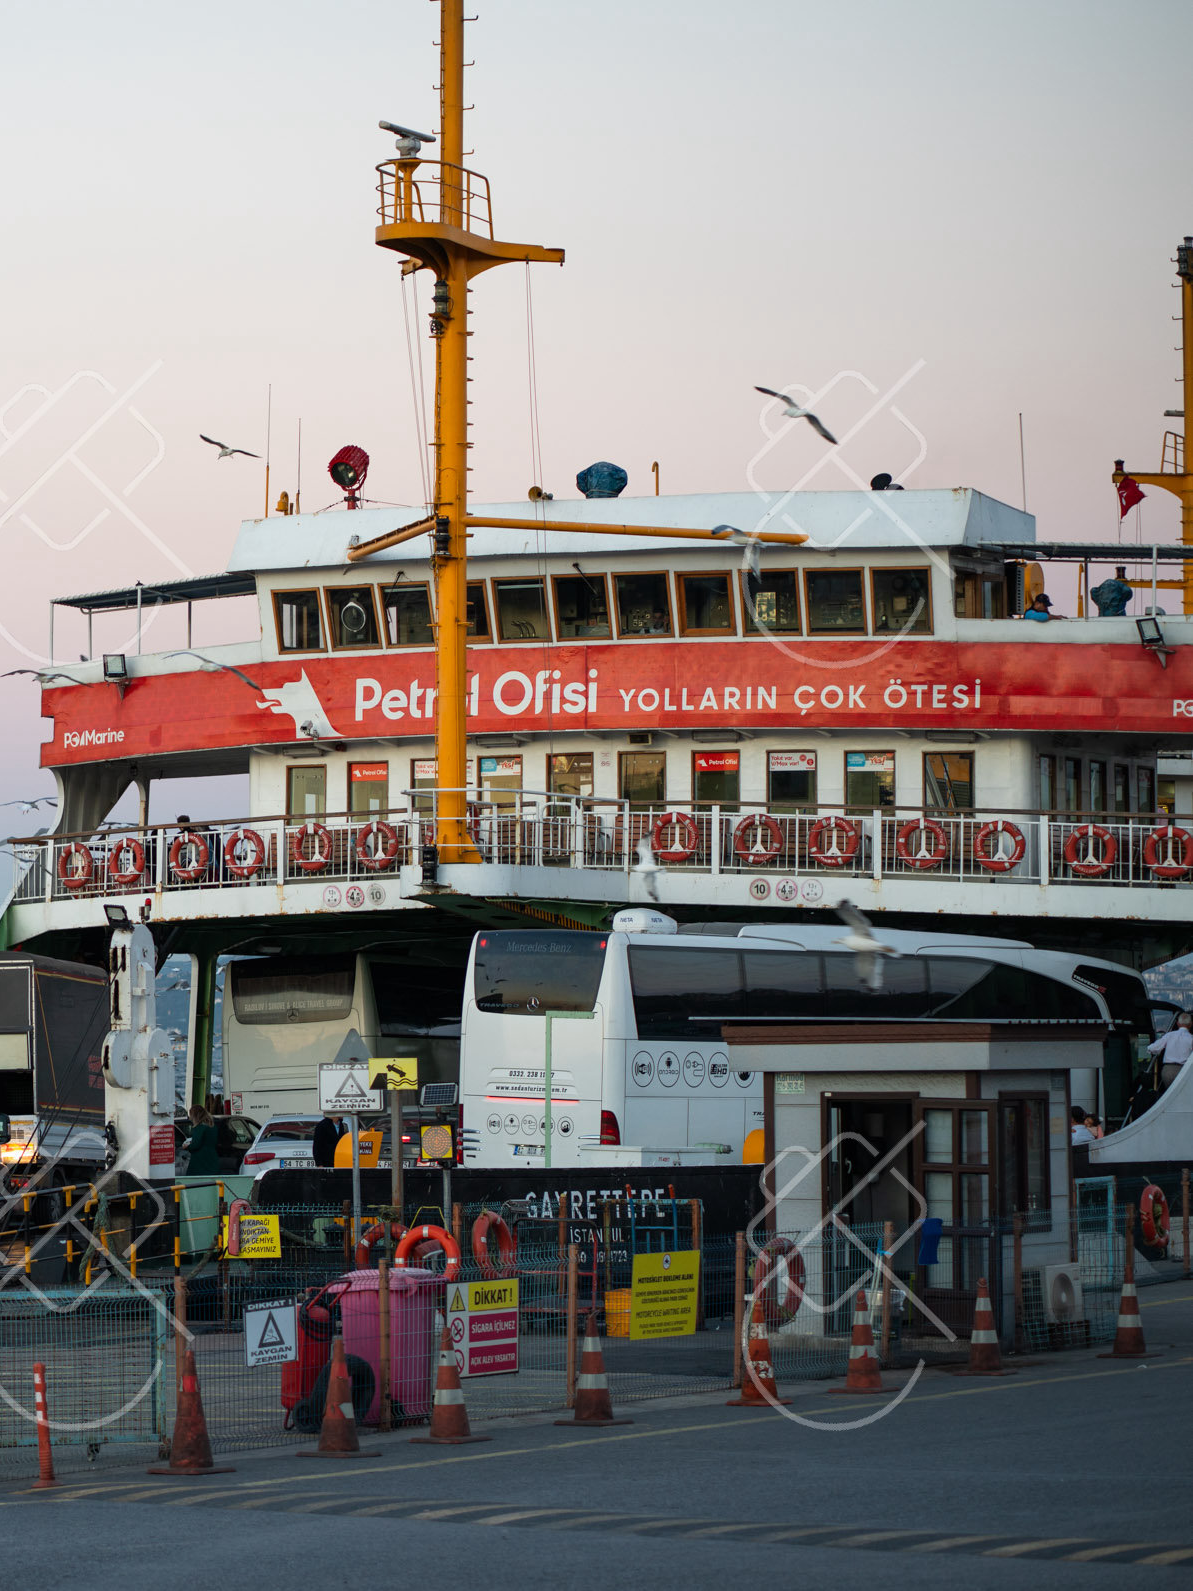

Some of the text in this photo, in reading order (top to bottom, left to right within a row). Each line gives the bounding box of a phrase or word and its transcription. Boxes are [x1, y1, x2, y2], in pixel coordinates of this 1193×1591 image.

[355, 668, 598, 721] Petrl Ofisi
[619, 678, 981, 716] YOLLARIN ÇOK ÖTESİ
[370, 891, 382, 900] 10
[754, 884, 766, 895] 10
[570, 1226, 624, 1243] İSTANUL
[474, 1287, 508, 1305] DİKKAT
[471, 1320, 494, 1334] SİGARA
[250, 1346, 292, 1357] KAYGAN
